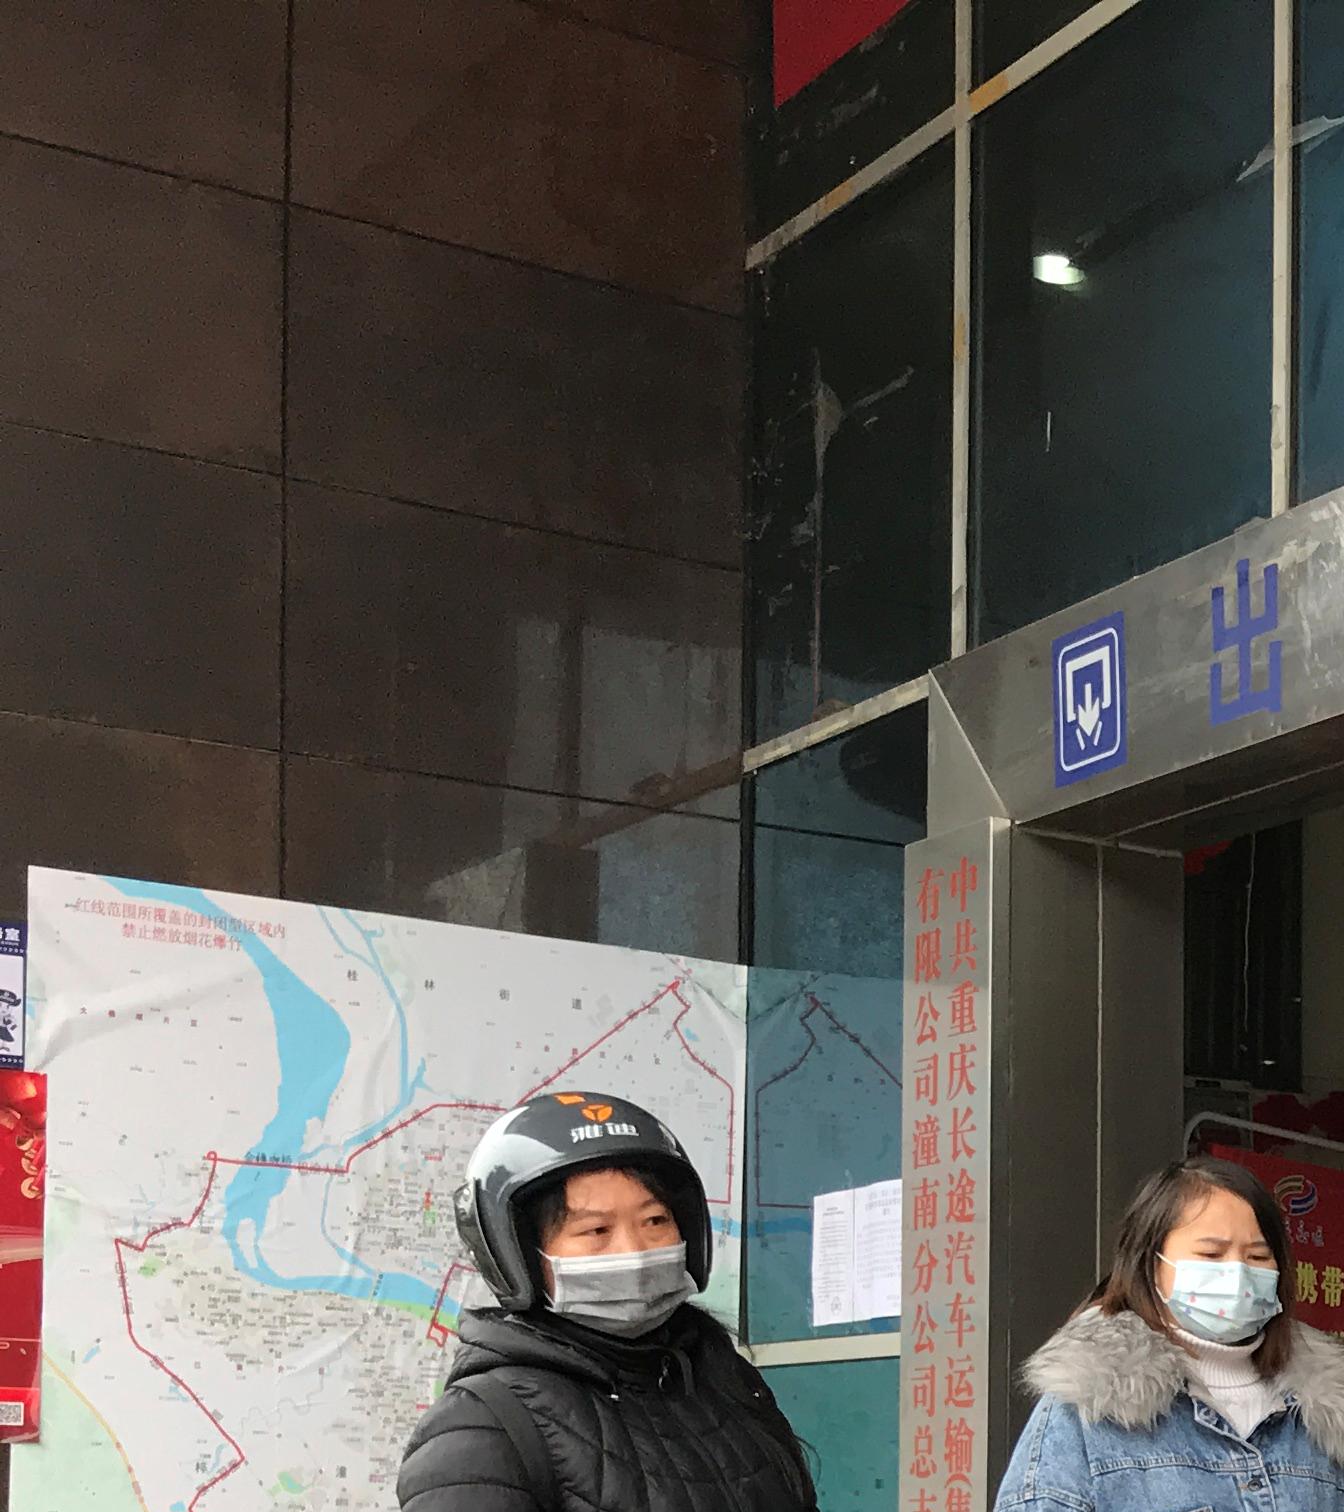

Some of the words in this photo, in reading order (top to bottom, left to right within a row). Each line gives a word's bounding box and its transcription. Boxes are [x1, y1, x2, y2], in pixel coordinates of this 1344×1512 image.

[74, 898, 286, 939] 红线范围所覆盖的封闭型区域内
[122, 923, 242, 952] 禁止燃放烟花爆竹
